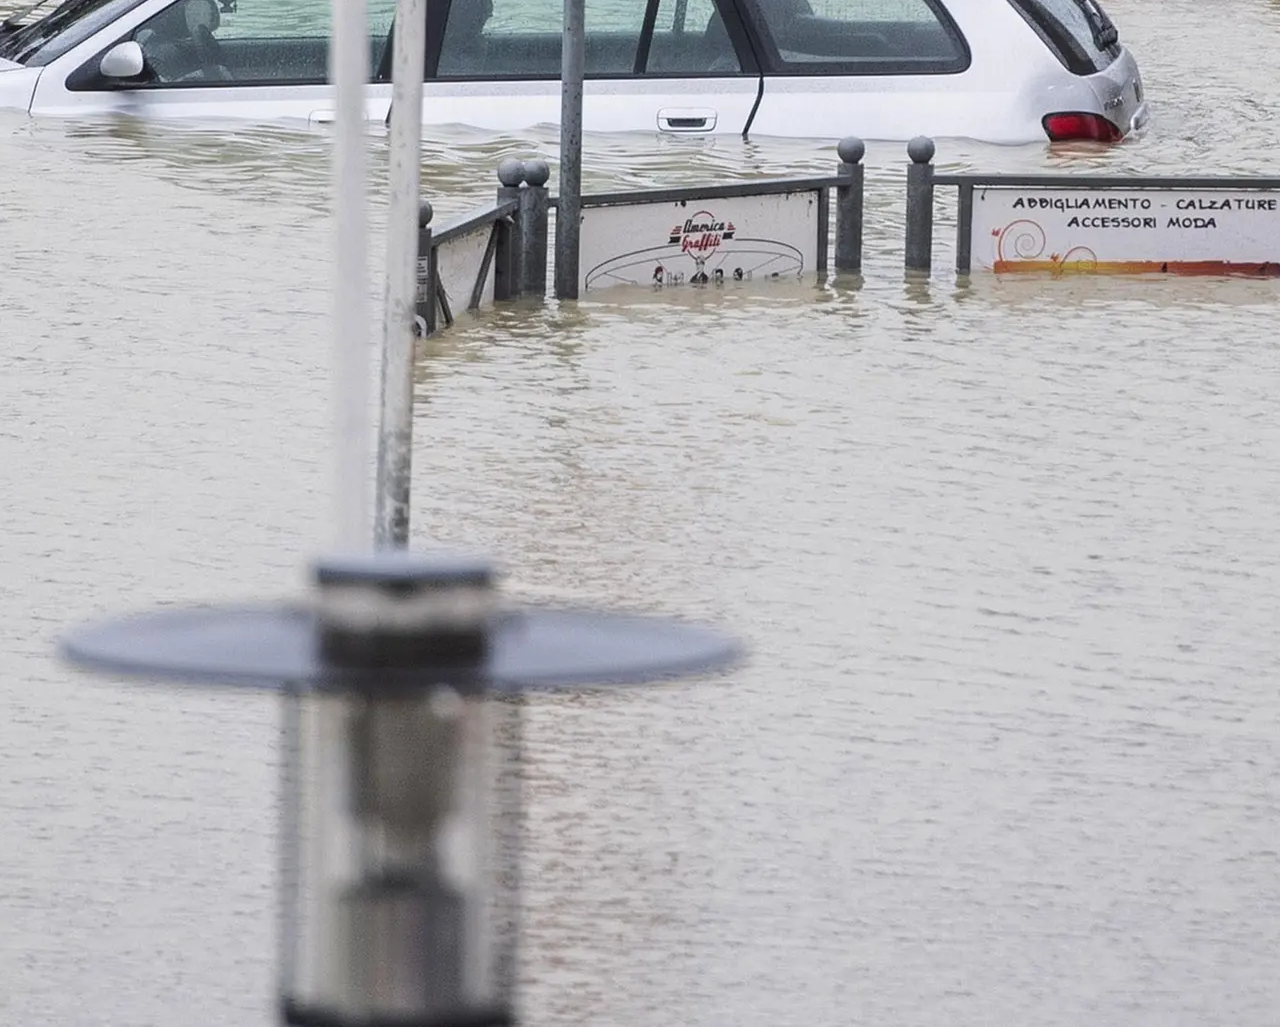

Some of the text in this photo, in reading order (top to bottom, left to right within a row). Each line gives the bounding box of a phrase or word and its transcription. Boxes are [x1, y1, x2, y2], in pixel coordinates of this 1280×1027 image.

[1013, 197, 1151, 213] ABBIGLIAMENTO
[1176, 198, 1277, 211] CALZATURE
[683, 219, 725, 234] America
[1067, 216, 1217, 229] ACCESSORI MODA
[681, 233, 721, 253] Graffiti
